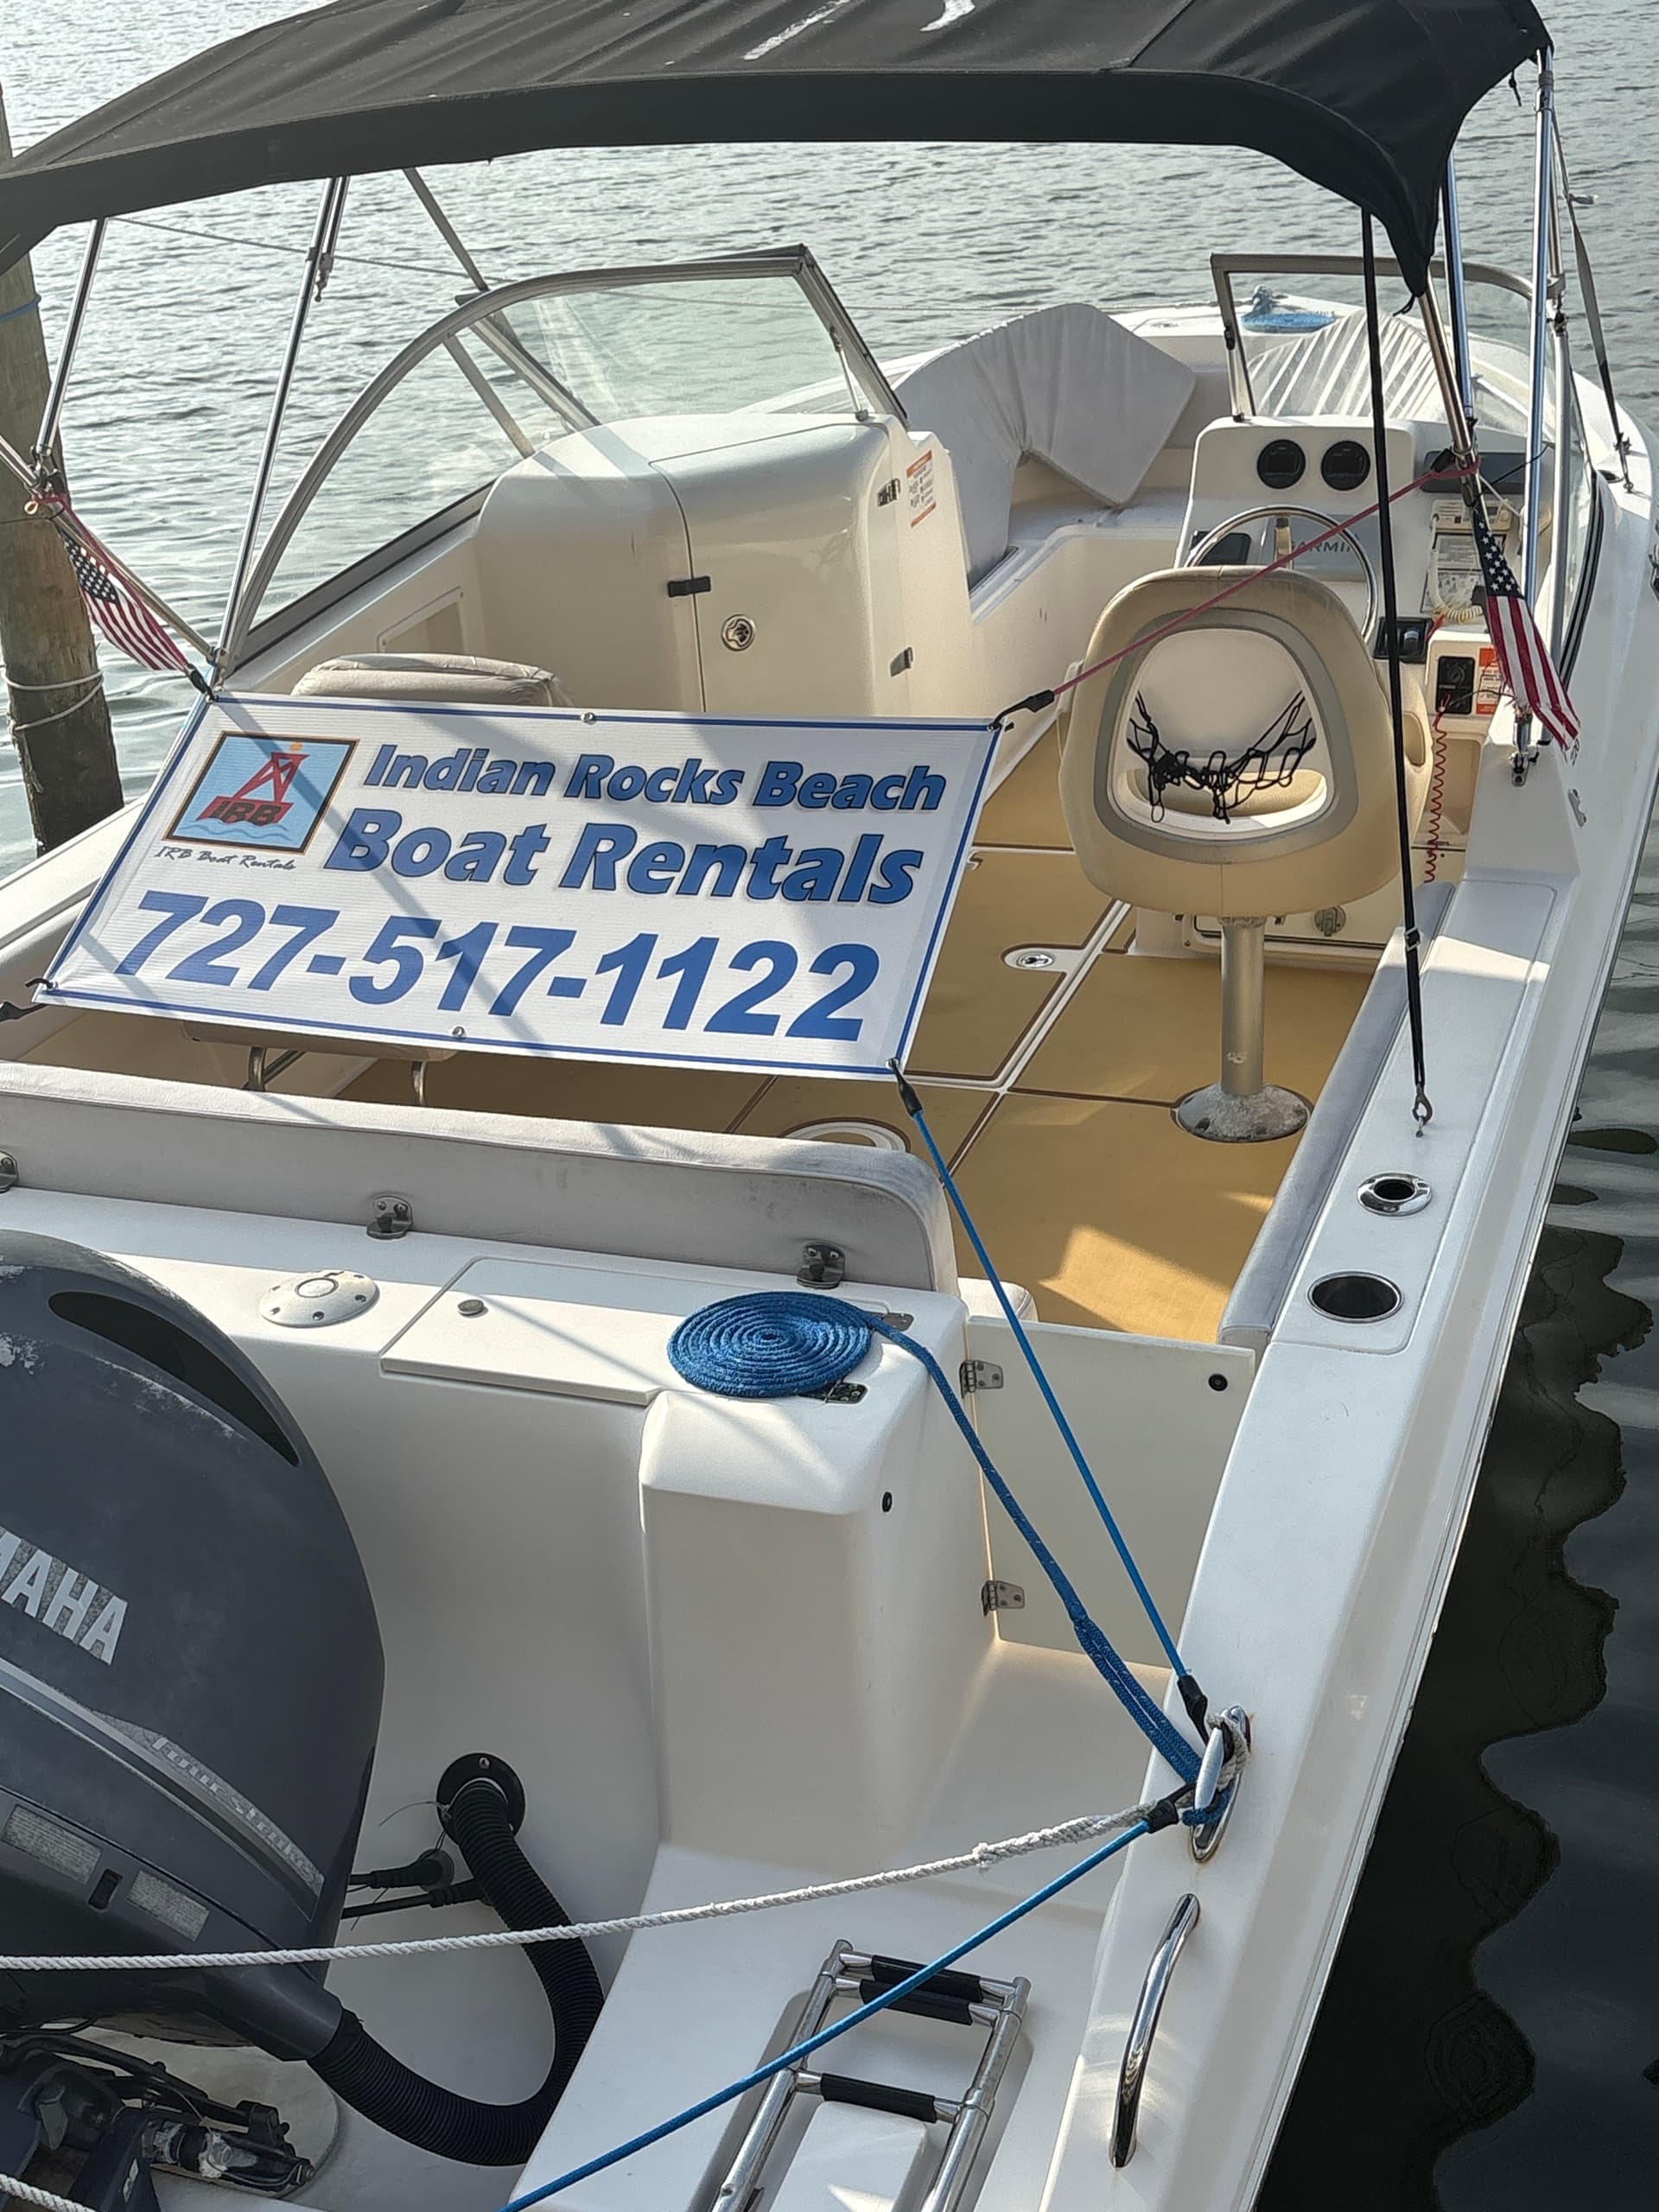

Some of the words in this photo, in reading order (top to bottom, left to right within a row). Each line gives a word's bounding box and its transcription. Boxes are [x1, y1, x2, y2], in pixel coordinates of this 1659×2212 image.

[364, 743, 556, 798] Indian
[563, 753, 745, 805] Rocks
[752, 760, 947, 810] Beach
[211, 799, 282, 826] IRB
[154, 845, 194, 861] IRB
[196, 850, 238, 865] Boat
[238, 854, 297, 870] Rentals
[324, 808, 551, 887] Boat
[558, 822, 925, 906] Rentals
[115, 890, 880, 1042] 727-517-1122
